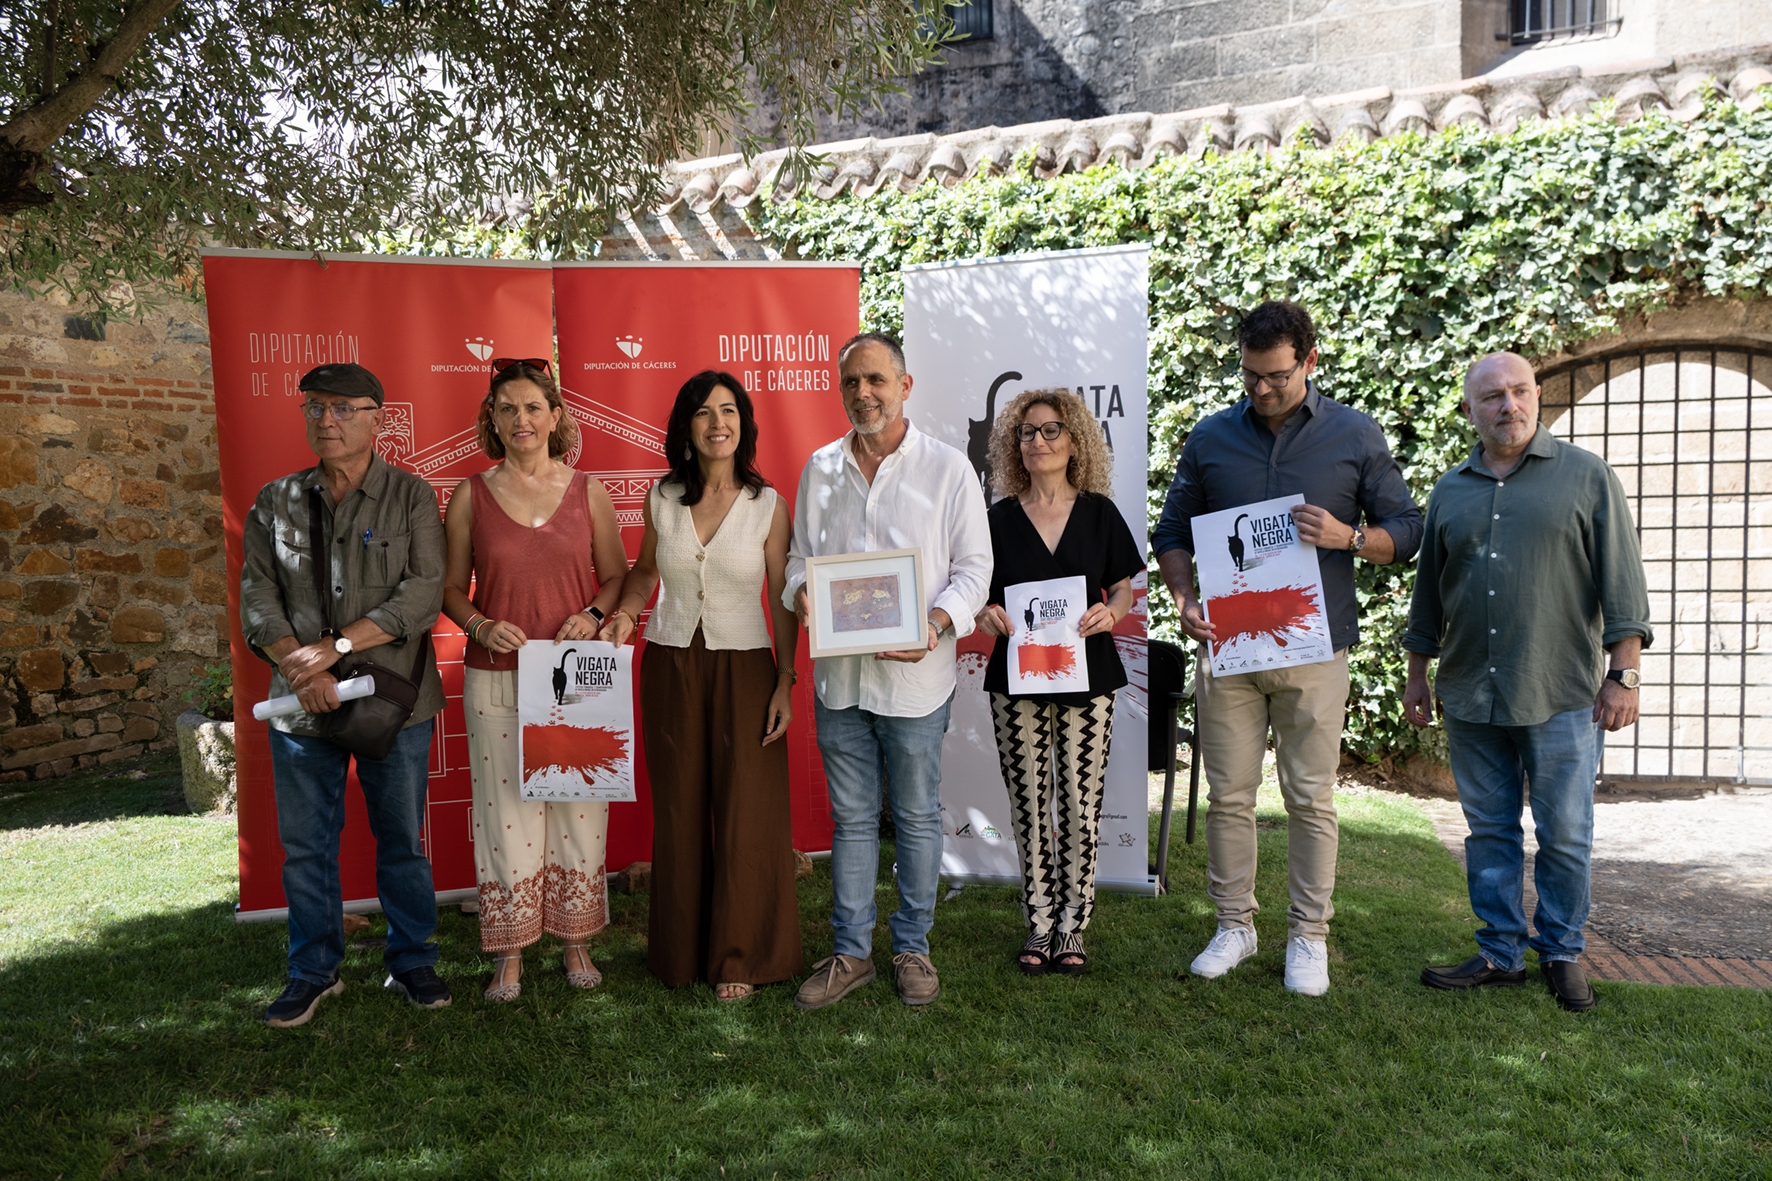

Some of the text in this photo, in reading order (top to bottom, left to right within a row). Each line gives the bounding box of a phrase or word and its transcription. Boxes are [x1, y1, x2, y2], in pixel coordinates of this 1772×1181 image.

[250, 330, 360, 364] DIPUTACIÓN
[719, 329, 830, 363] DIPUTACIÓN
[431, 363, 480, 372] DIPUTACIÓN
[481, 365, 491, 373] DE
[584, 361, 630, 370] DIPUTACIÓN
[643, 360, 677, 369] CÁCERES
[252, 372, 269, 397] DE
[744, 366, 830, 392] DE CÁCERES
[1250, 512, 1296, 534] VIGATA
[1251, 528, 1293, 548] NEGRA
[1039, 598, 1069, 610] VIGATA
[1040, 607, 1066, 618] NEGRA
[576, 656, 617, 671] VIGATA
[575, 671, 613, 686] NEGRA
